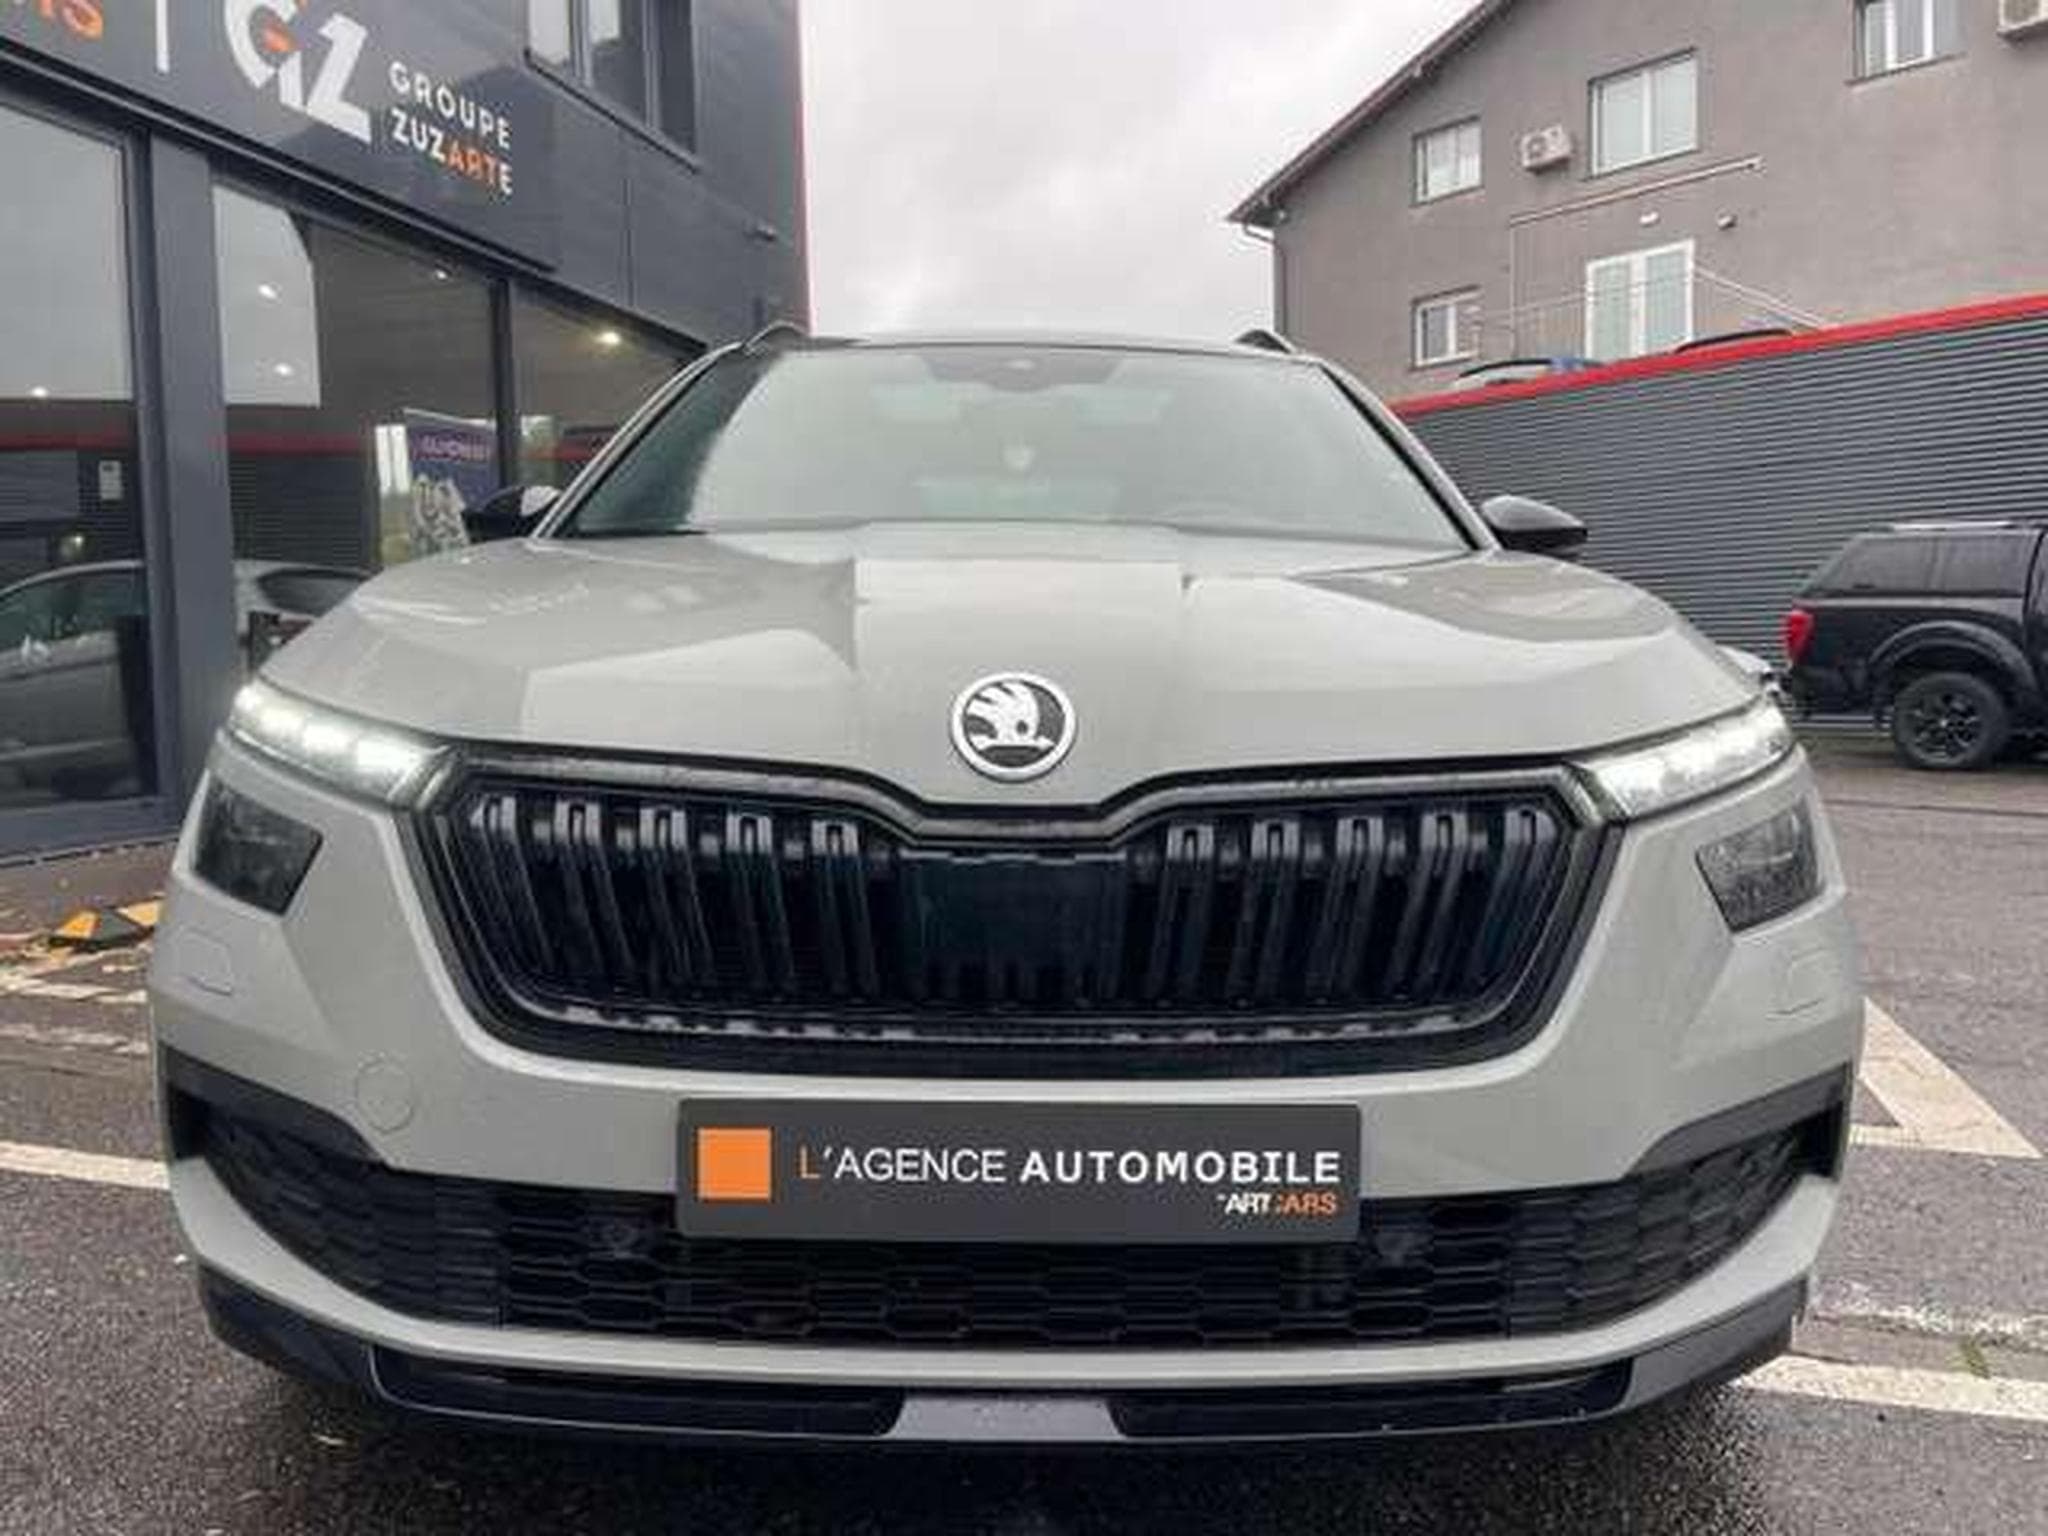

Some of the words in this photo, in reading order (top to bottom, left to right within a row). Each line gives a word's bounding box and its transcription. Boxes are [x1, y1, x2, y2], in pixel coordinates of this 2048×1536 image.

[389, 61, 511, 150] GROUPE
[391, 107, 513, 195] ZUZARTE
[800, 1146, 1006, 1182] L'AGENCE
[1020, 1150, 1340, 1183] AUTOMOBILE
